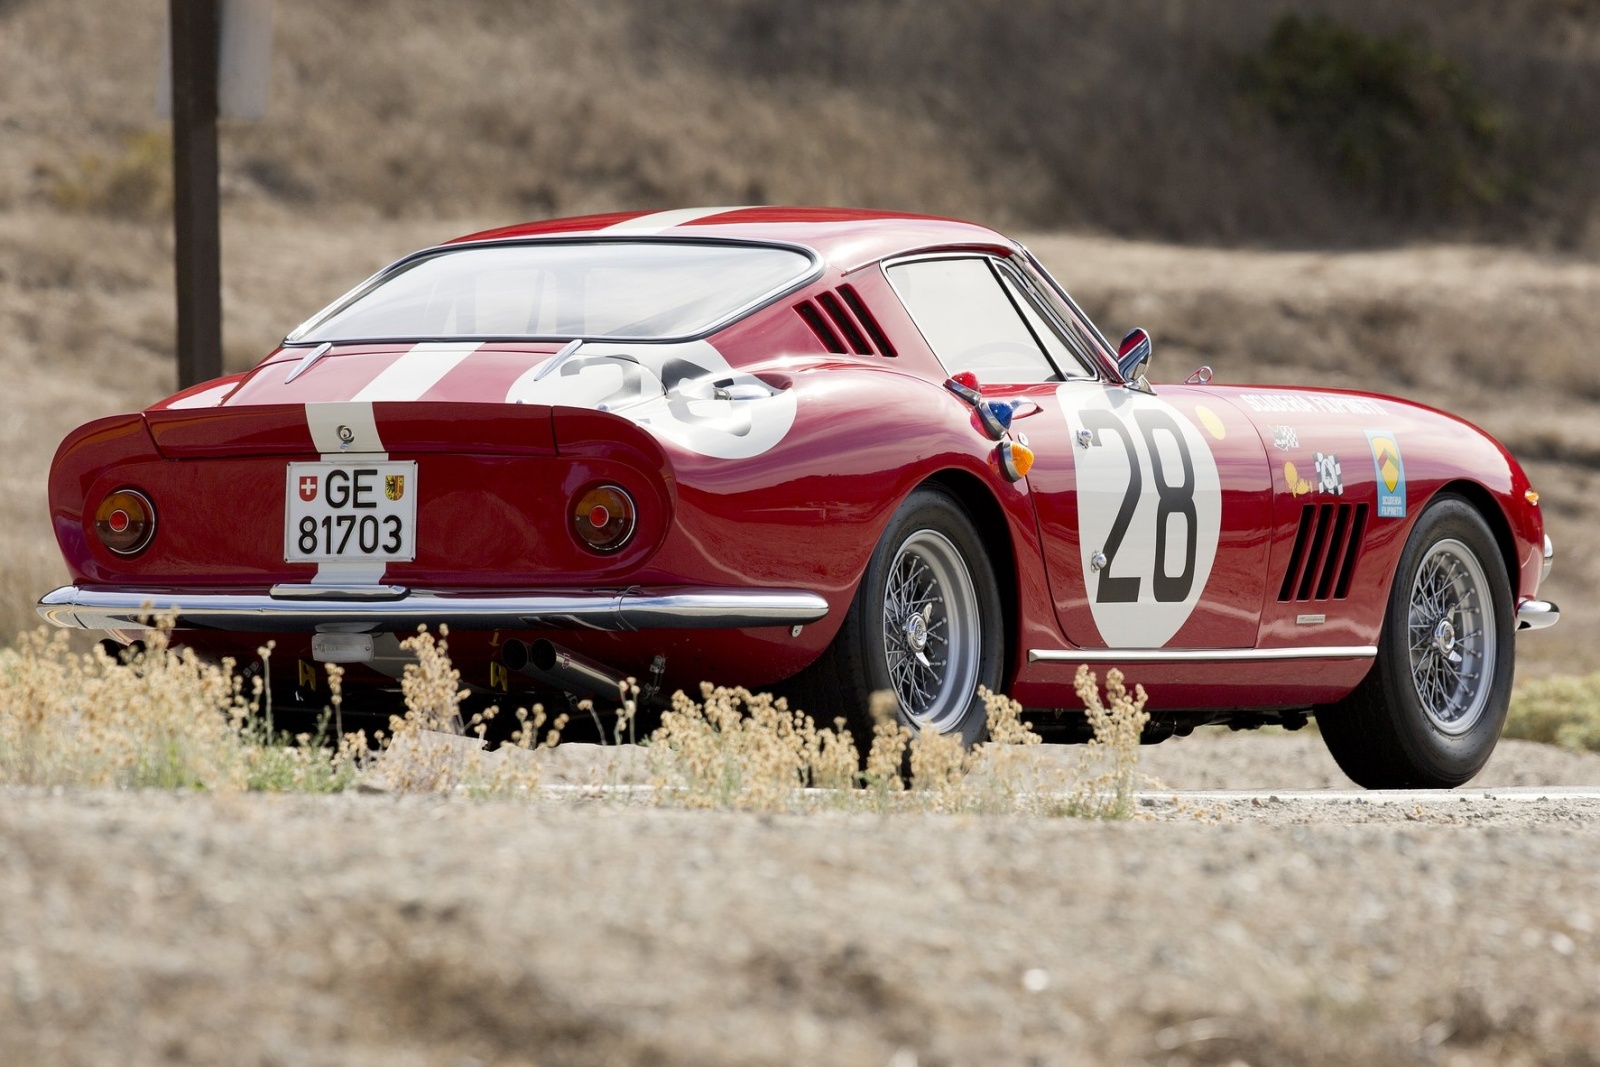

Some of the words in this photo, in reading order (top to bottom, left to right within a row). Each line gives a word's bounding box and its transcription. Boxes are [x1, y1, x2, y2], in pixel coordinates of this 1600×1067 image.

[325, 469, 378, 508] GE
[1078, 409, 1198, 603] 28
[298, 515, 402, 554] 81703
